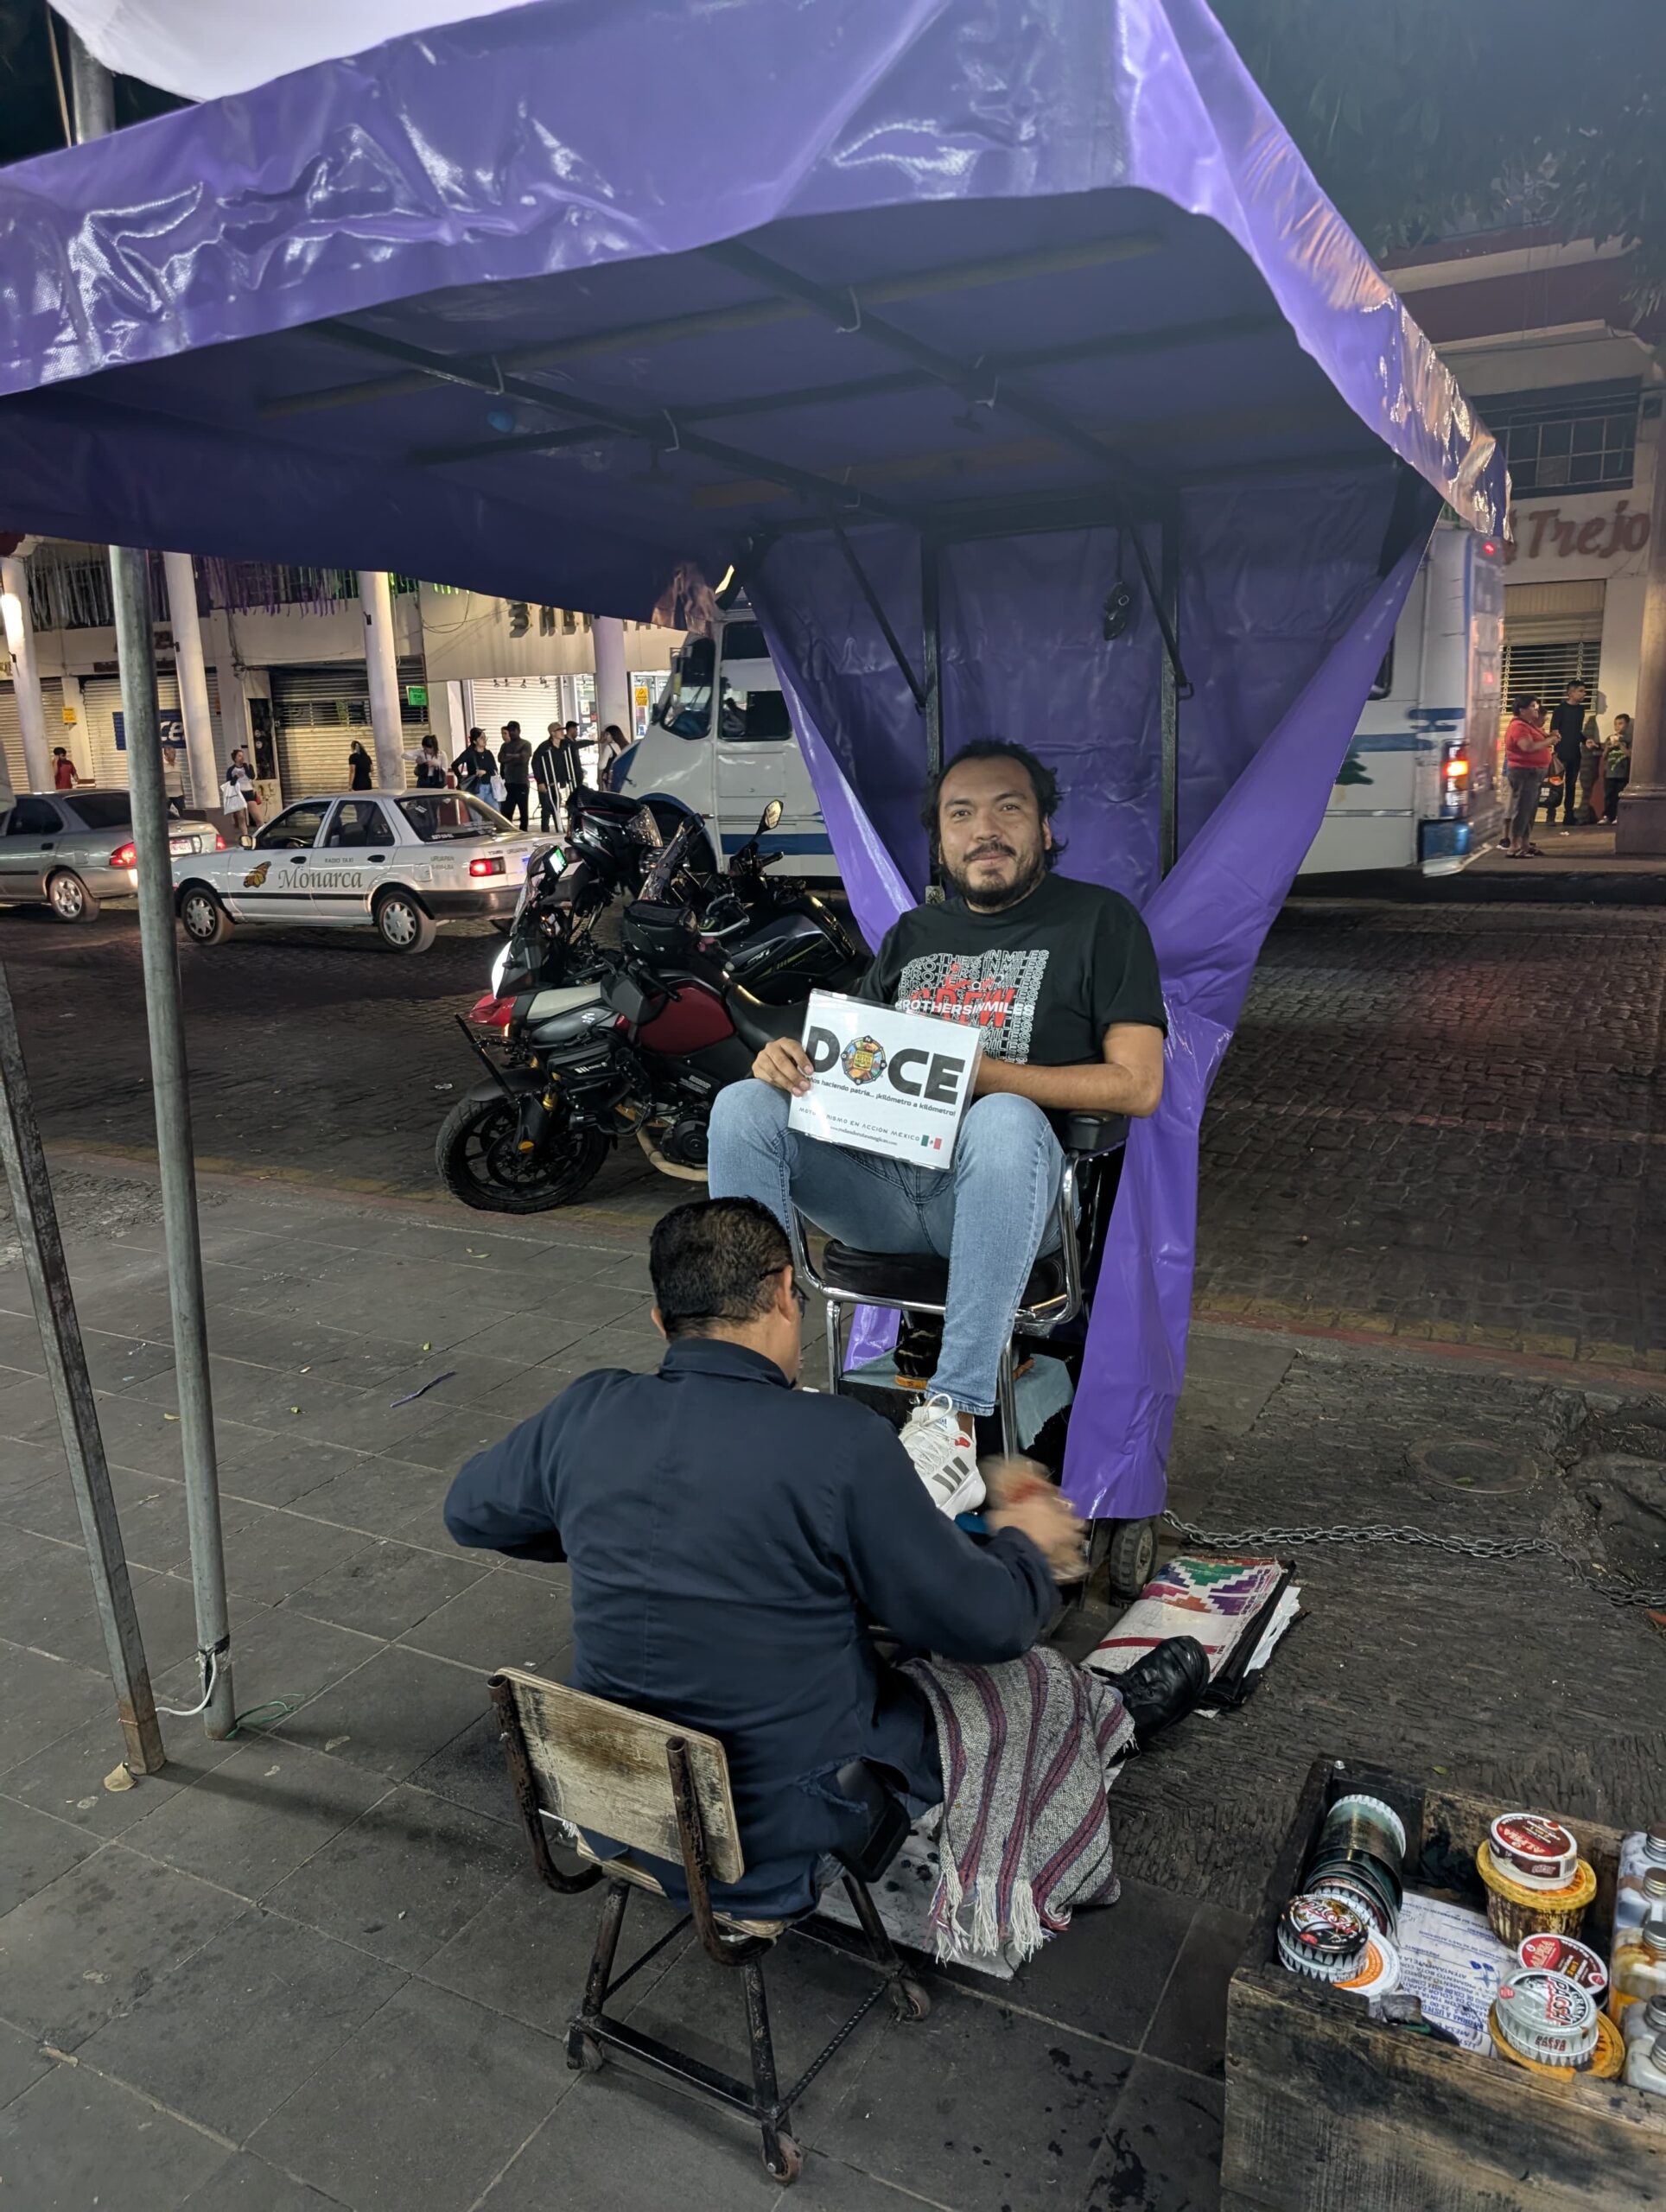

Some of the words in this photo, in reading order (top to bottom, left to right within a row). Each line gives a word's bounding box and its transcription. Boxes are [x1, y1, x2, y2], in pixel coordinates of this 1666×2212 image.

[1529, 499, 1651, 559] Trejo
[278, 868, 364, 890] Monarca
[820, 1080, 849, 1091] haciendo
[919, 1103, 956, 1116] kilómetro!
[861, 1122, 888, 1134] ACCIÓN
[1428, 1988, 1453, 1999] COLOR
[1547, 1976, 1573, 2025] PACSA
